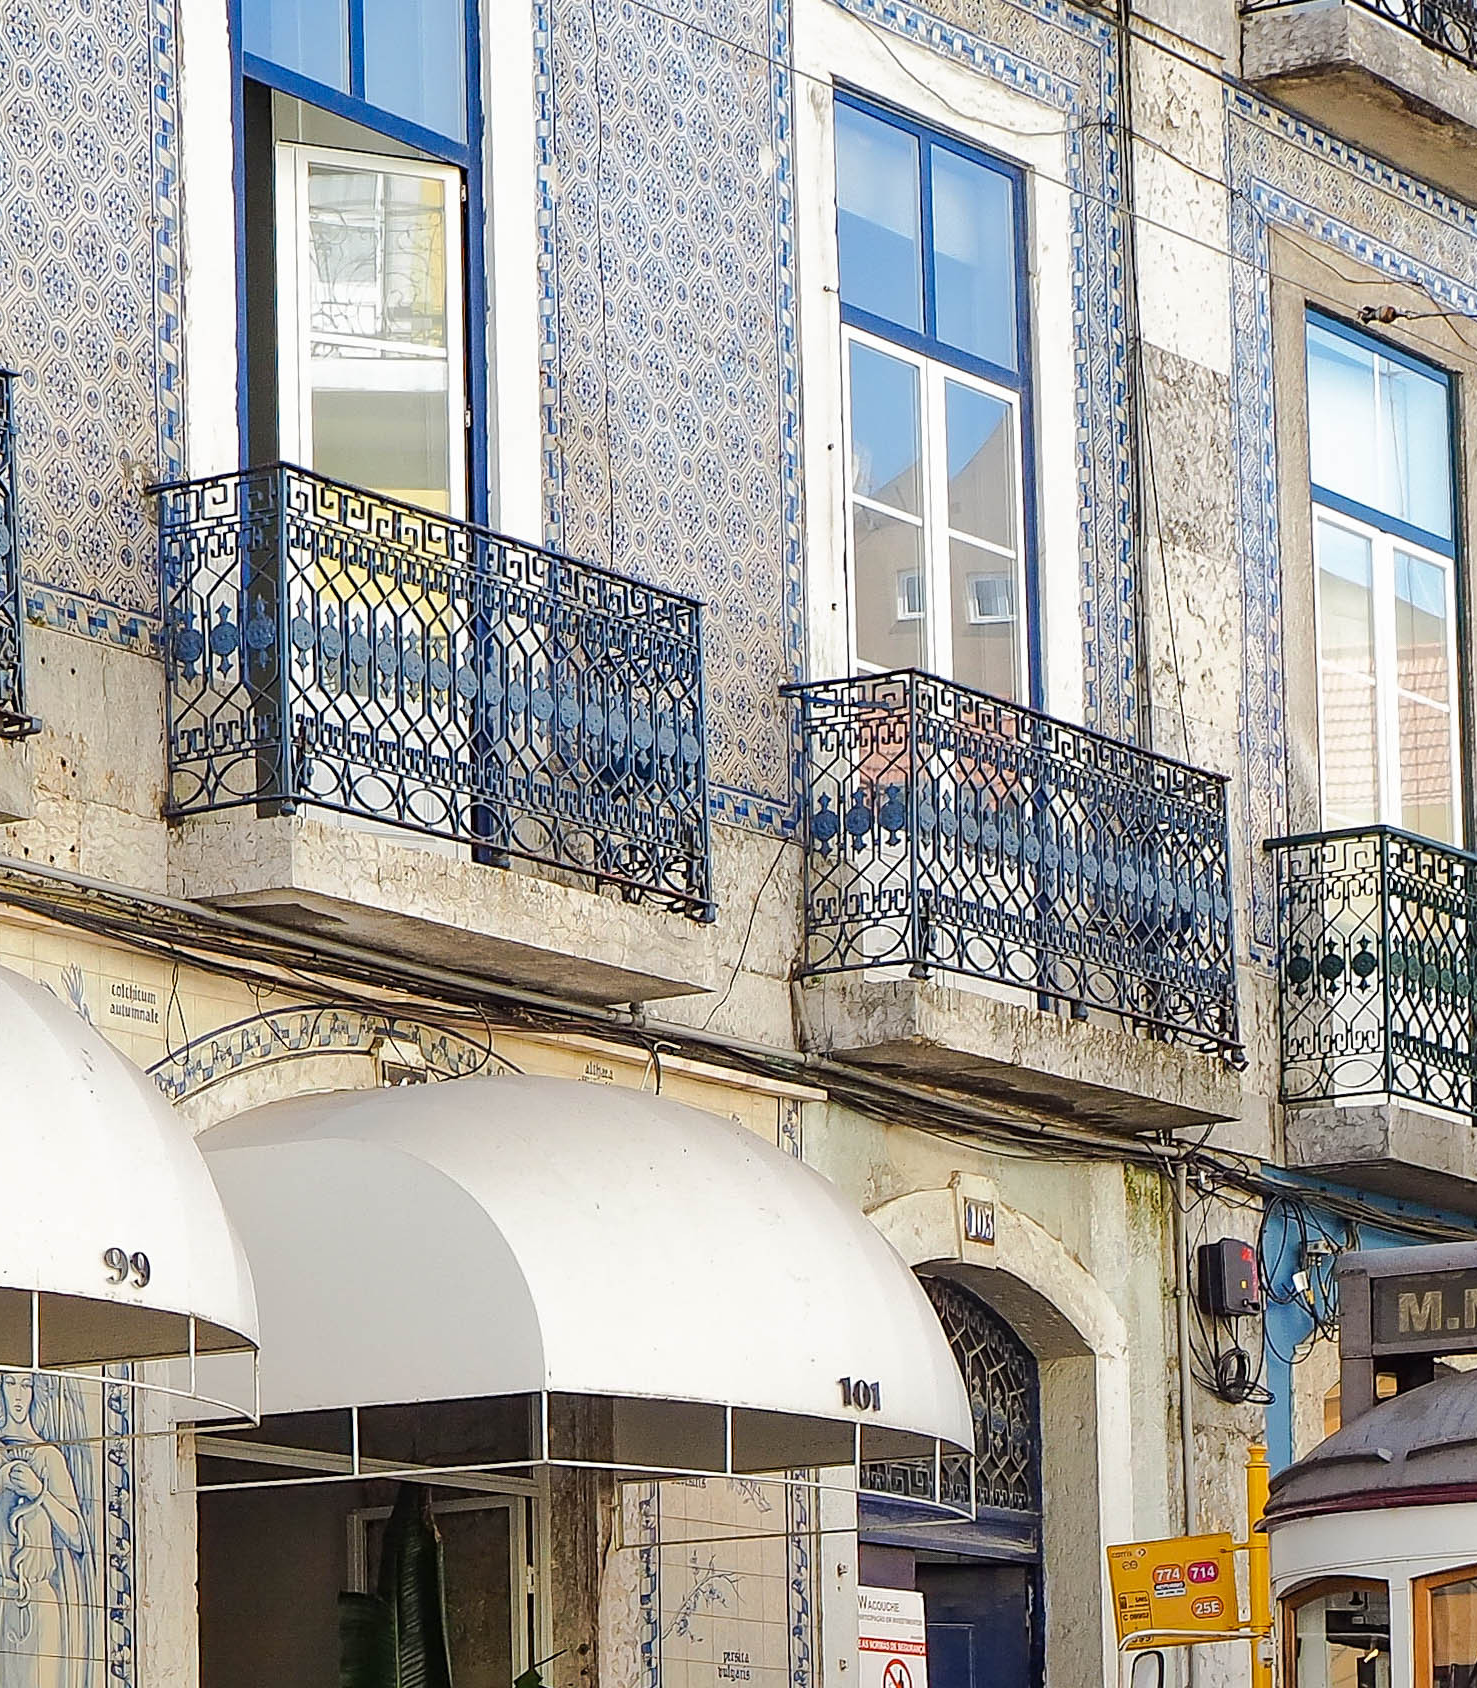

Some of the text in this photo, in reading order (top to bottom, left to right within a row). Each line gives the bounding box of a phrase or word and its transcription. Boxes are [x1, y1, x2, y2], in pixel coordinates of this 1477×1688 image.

[966, 1201, 994, 1240] 103
[103, 1246, 152, 1290] 99
[838, 1375, 882, 1412] 101
[1156, 1566, 1216, 1581] 774 714
[1195, 1601, 1220, 1615] 25E
